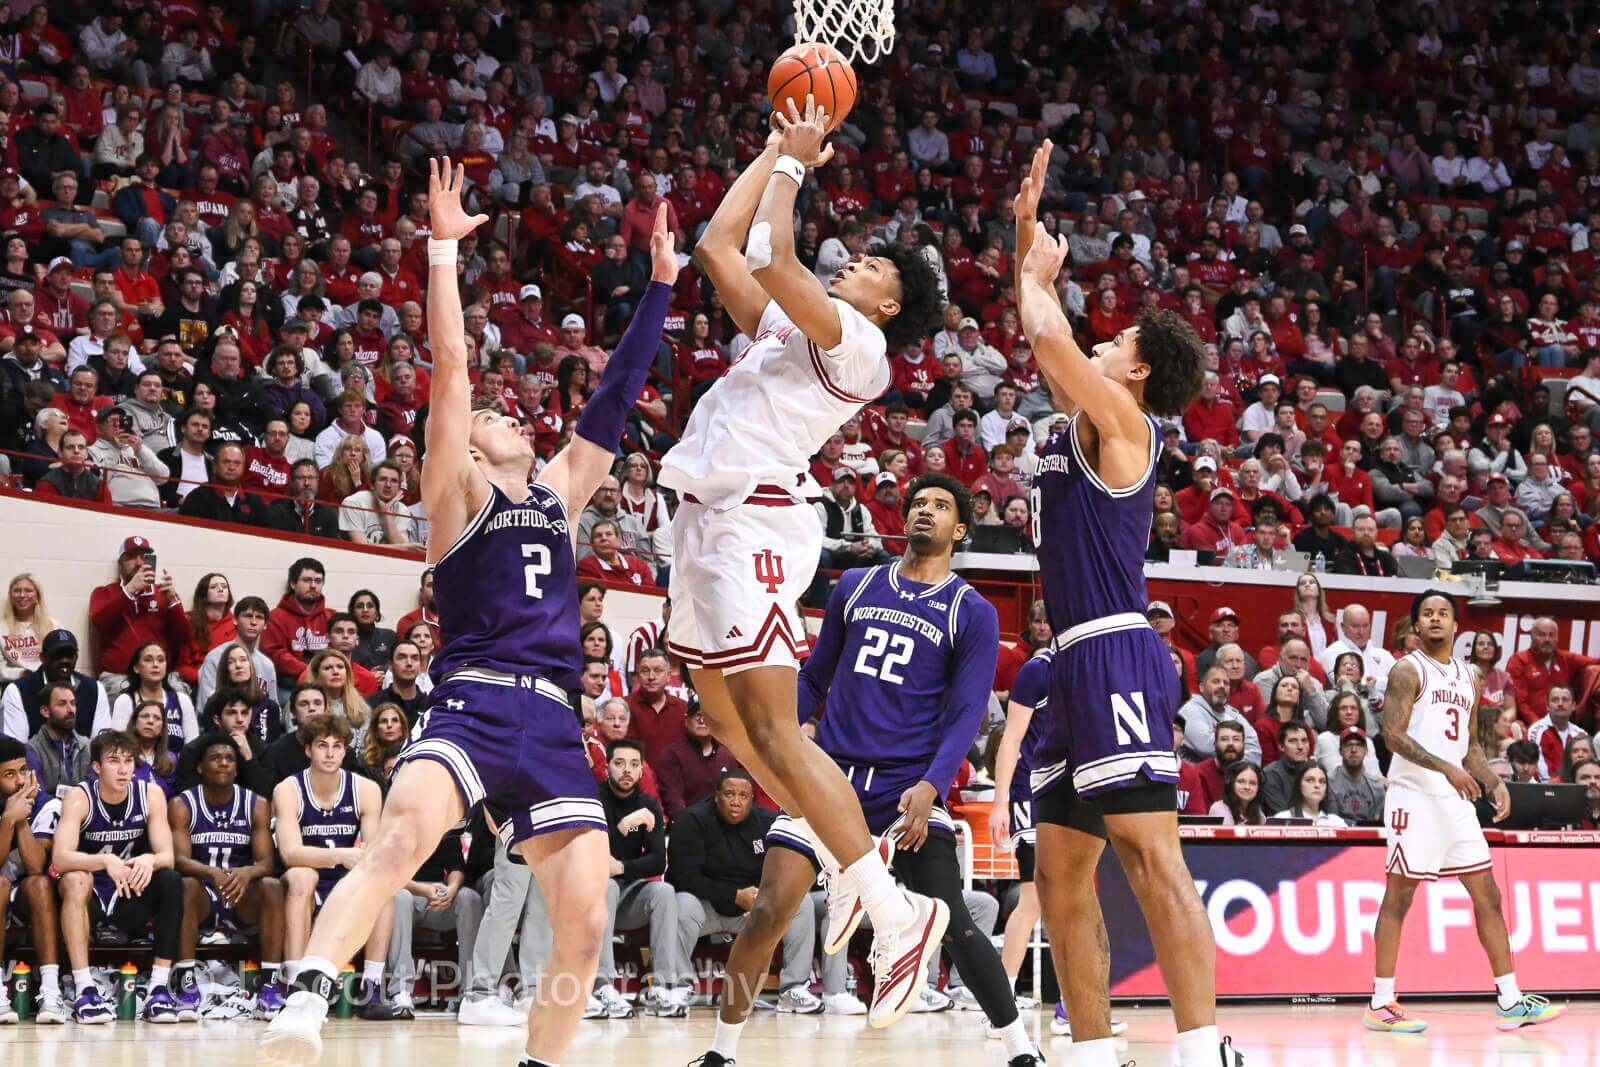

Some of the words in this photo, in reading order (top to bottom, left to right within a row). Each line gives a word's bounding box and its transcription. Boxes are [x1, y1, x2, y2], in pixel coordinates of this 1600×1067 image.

[521, 543, 552, 599] 2
[851, 606, 944, 648] NORTHWESTERN
[3, 635, 39, 651] INDIA
[853, 626, 915, 686] 22
[521, 675, 532, 690] N
[1432, 689, 1471, 713] INDIANA
[1110, 691, 1151, 746] N
[1444, 708, 1460, 741] 3
[302, 824, 357, 836] NORTHWESTERN
[1013, 801, 1031, 830] N
[85, 828, 145, 842] NORTHWESTERN
[190, 832, 250, 845] NORTHWESTERN
[1198, 879, 1386, 954] OUR
[1426, 879, 1600, 954] FE
